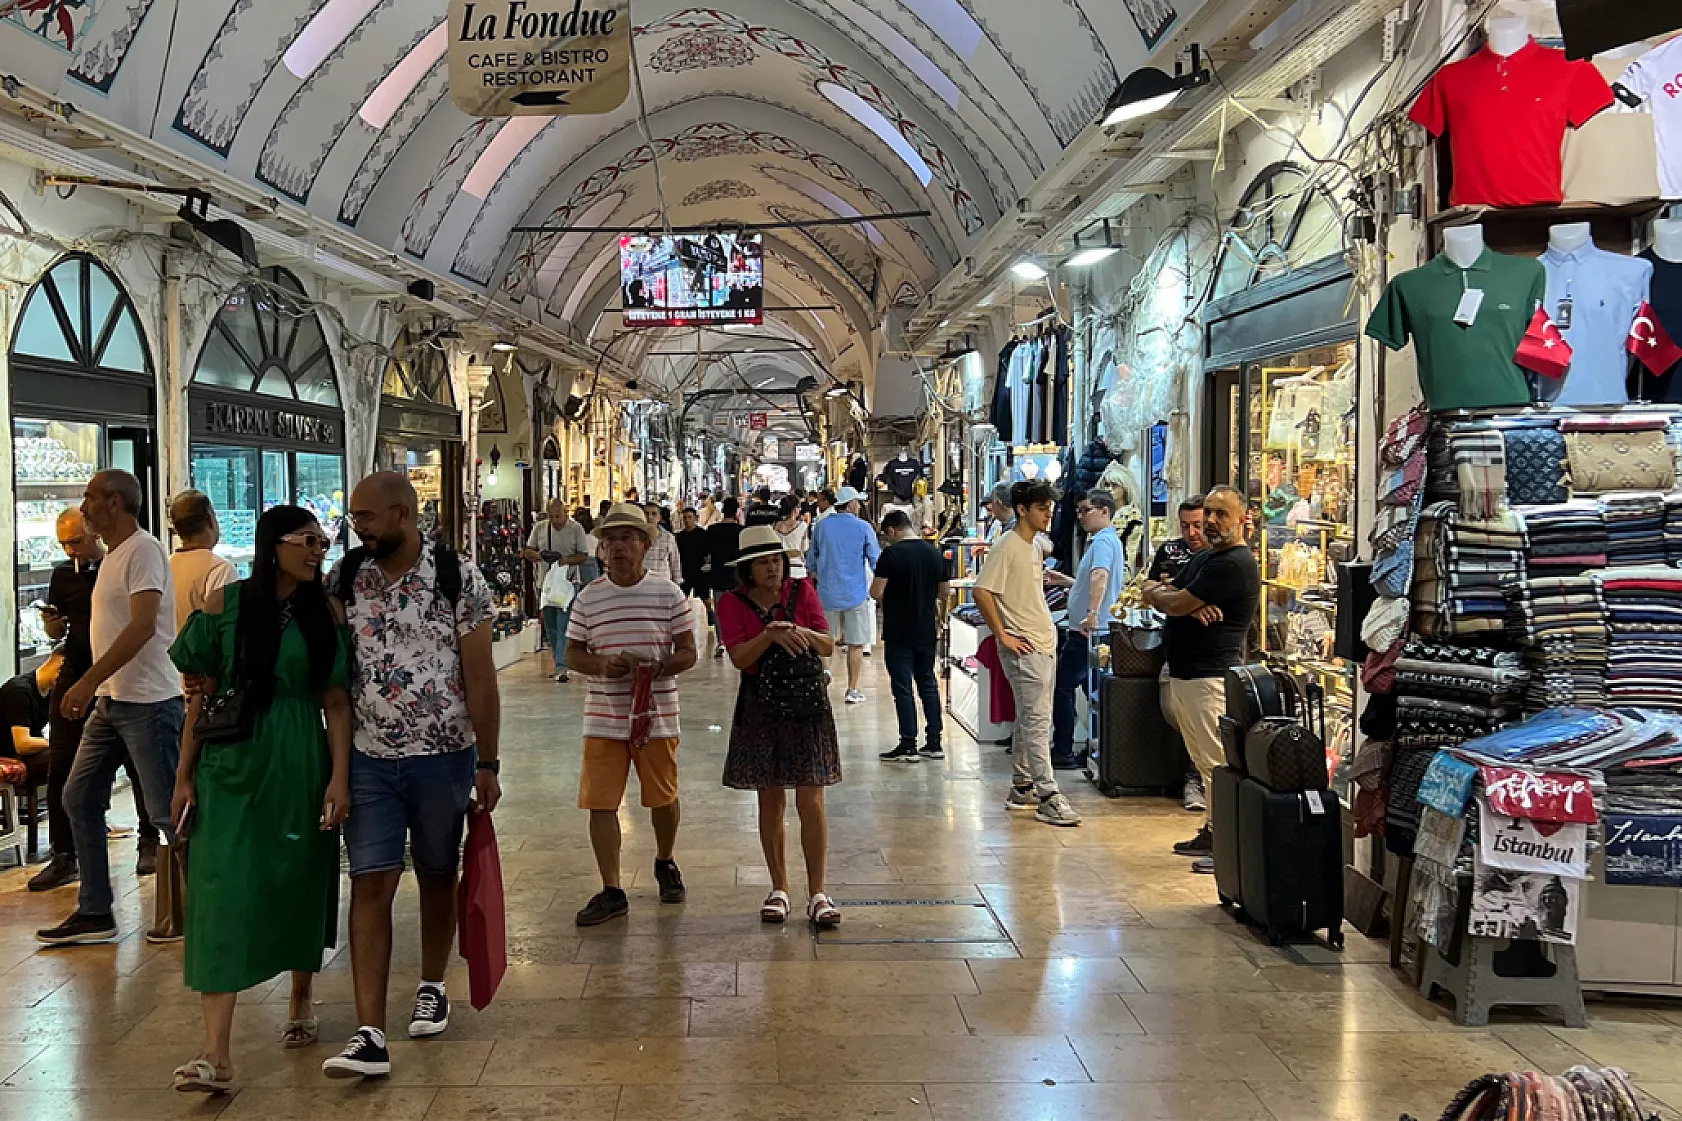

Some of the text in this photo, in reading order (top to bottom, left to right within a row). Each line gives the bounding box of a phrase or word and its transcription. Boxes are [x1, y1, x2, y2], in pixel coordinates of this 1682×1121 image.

[458, 0, 617, 42] La Fondue
[468, 49, 609, 69] CAFE & BISTRO
[483, 68, 596, 87] RESTORANT
